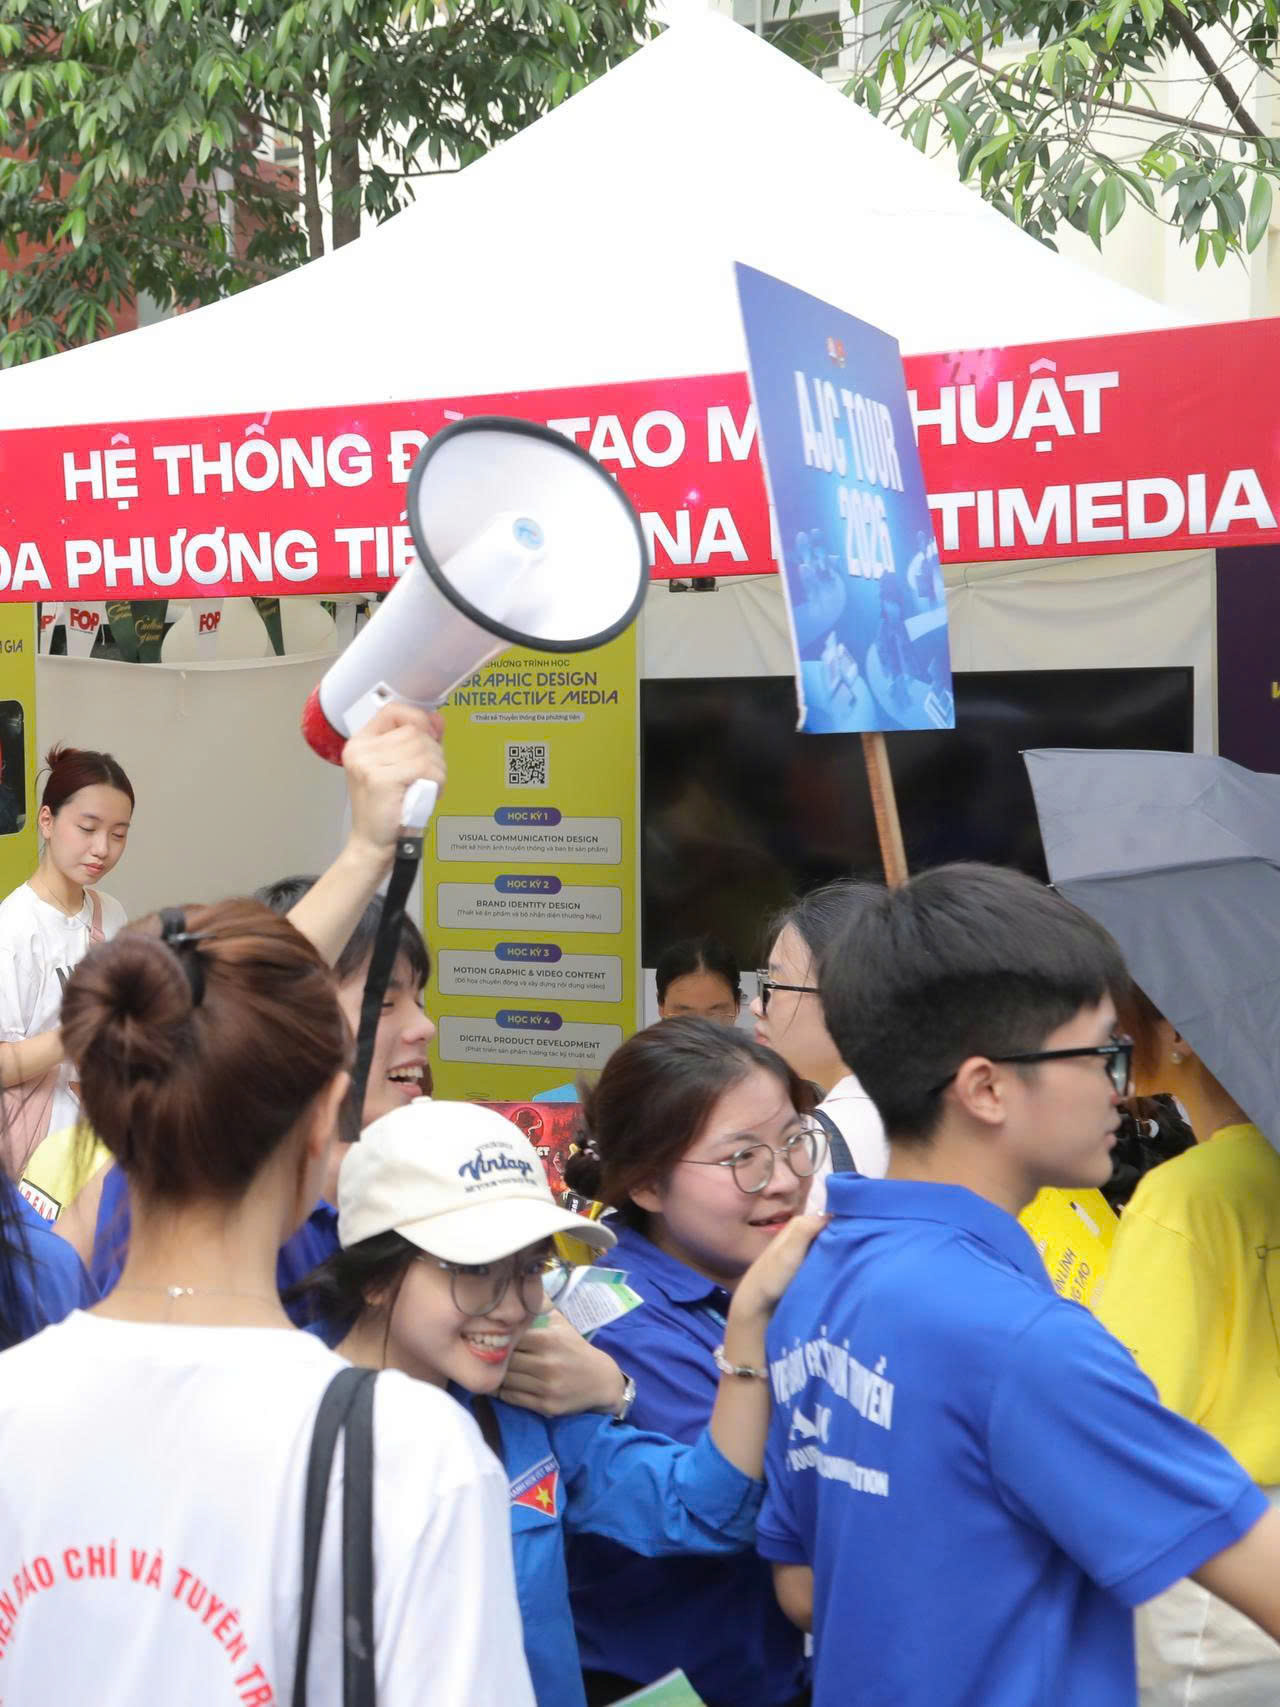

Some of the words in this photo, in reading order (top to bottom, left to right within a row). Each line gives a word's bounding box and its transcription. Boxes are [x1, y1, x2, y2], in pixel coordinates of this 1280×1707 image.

[62, 433, 138, 510] HỆ
[154, 412, 373, 495] THỐNG
[909, 357, 1119, 453] HUẬT
[794, 371, 847, 477] AJC
[841, 389, 904, 492] TOUR
[65, 527, 318, 588] PHƯƠNG
[926, 469, 1278, 551] TIMEDIA
[70, 608, 100, 631] FOP
[199, 612, 221, 632] FOP
[5, 639, 23, 654] GIA
[524, 657, 550, 668] TRÌNH
[537, 672, 597, 687] DESIGN
[454, 691, 555, 706] INTERACTIVE
[560, 690, 618, 705] MEDIA
[507, 812, 528, 822] HỌC
[543, 813, 548, 821] 1
[458, 834, 488, 842] VISUAL
[490, 834, 564, 843] COMMUNICATION
[566, 835, 599, 843] DESIGN
[507, 881, 528, 890] HỌC
[543, 881, 550, 889] 2
[476, 900, 506, 908] BRAND
[508, 901, 546, 909] IDENTITY
[548, 902, 581, 910] DESIGN
[507, 948, 528, 957] HỌC
[543, 949, 550, 957] 3
[453, 967, 487, 975] MOTION
[489, 968, 527, 976] GRAPHIC
[536, 970, 563, 978] VIDEO
[565, 971, 606, 979] CONTENT
[507, 1015, 528, 1025] HỌC
[543, 1017, 551, 1025] 4
[459, 1035, 492, 1043] DIGITAL
[494, 1036, 534, 1046] PRODUCT
[536, 1039, 600, 1049] DEVELOPMENT
[20, 1186, 53, 1220] RENA
[63, 1538, 117, 1580] CHÍ
[130, 1548, 163, 1590] VÀ
